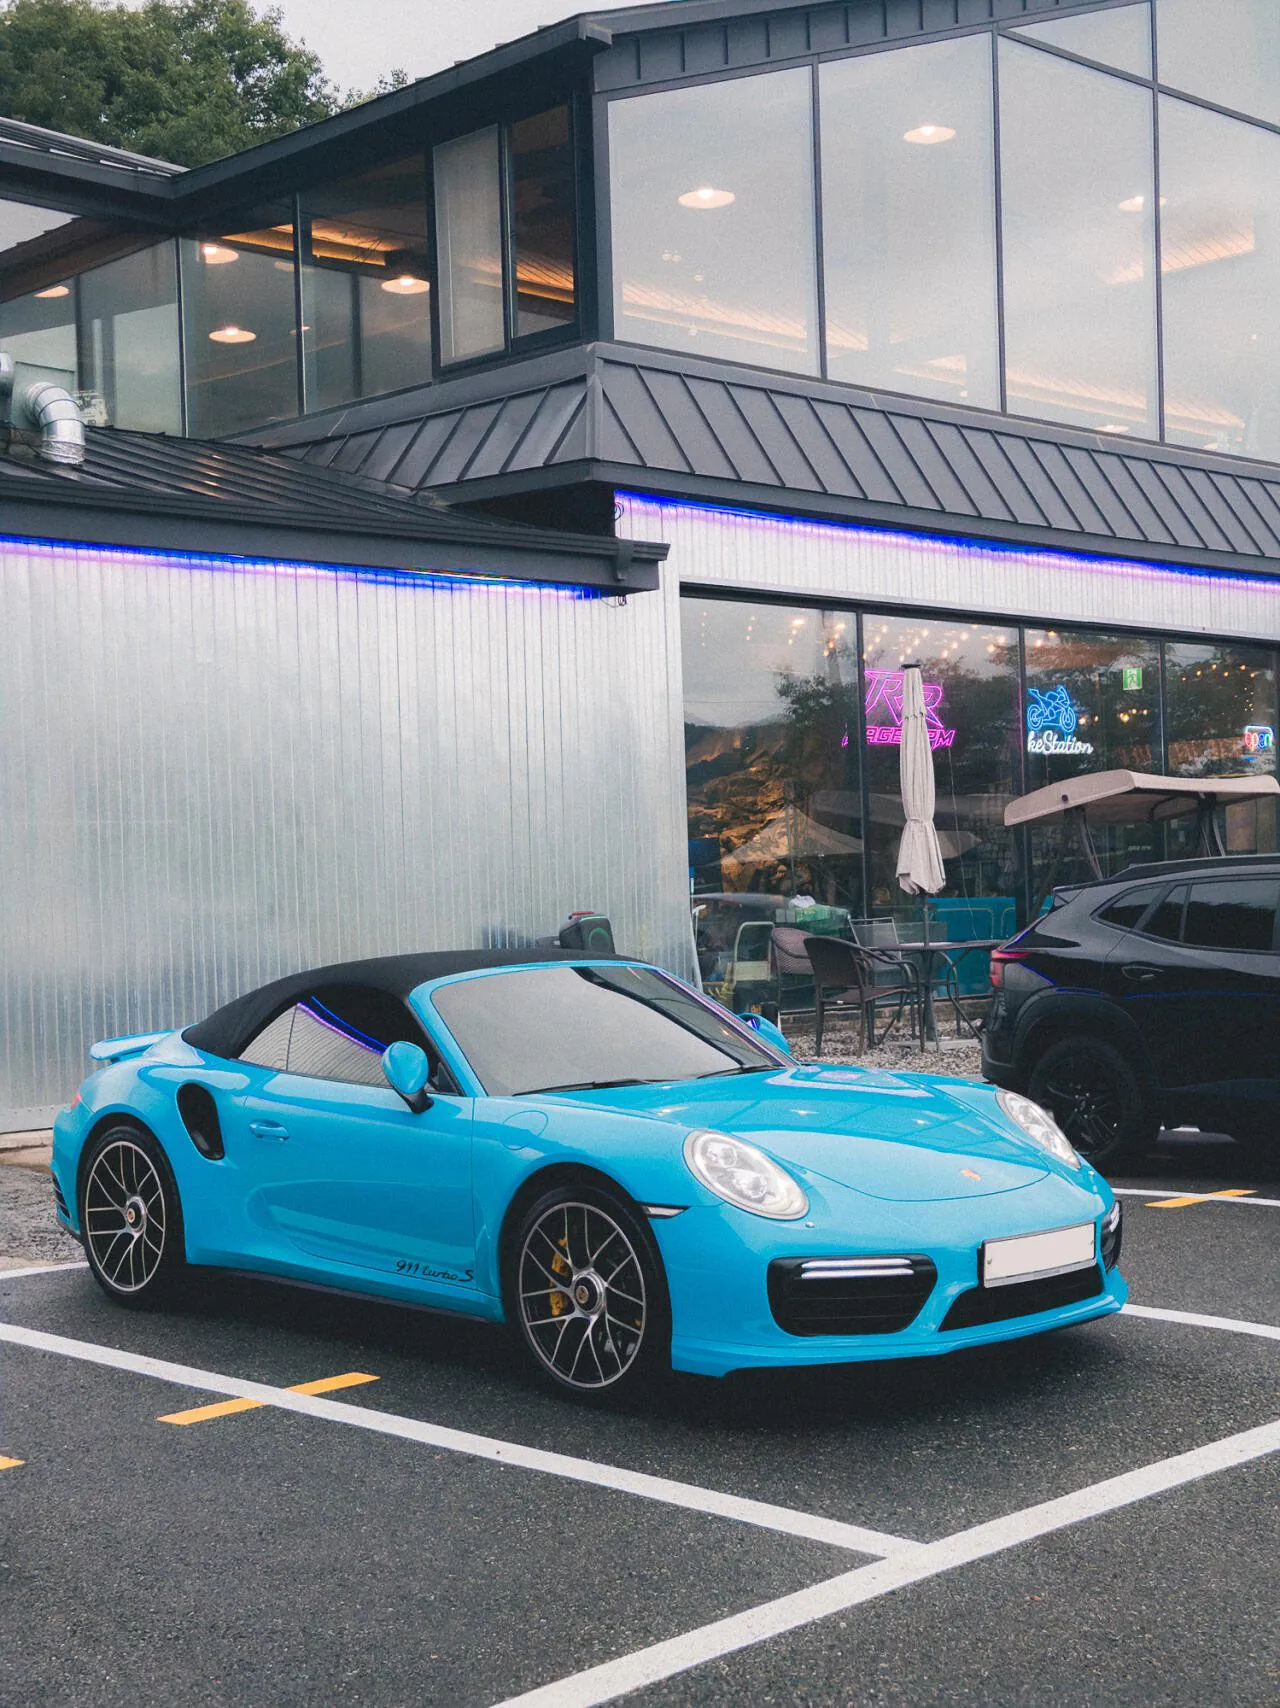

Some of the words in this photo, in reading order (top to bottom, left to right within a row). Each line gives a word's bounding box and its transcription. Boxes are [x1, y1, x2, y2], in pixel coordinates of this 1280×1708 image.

[395, 1260, 420, 1273] 911
[422, 1265, 458, 1281] turbo
[457, 1269, 475, 1282] S
